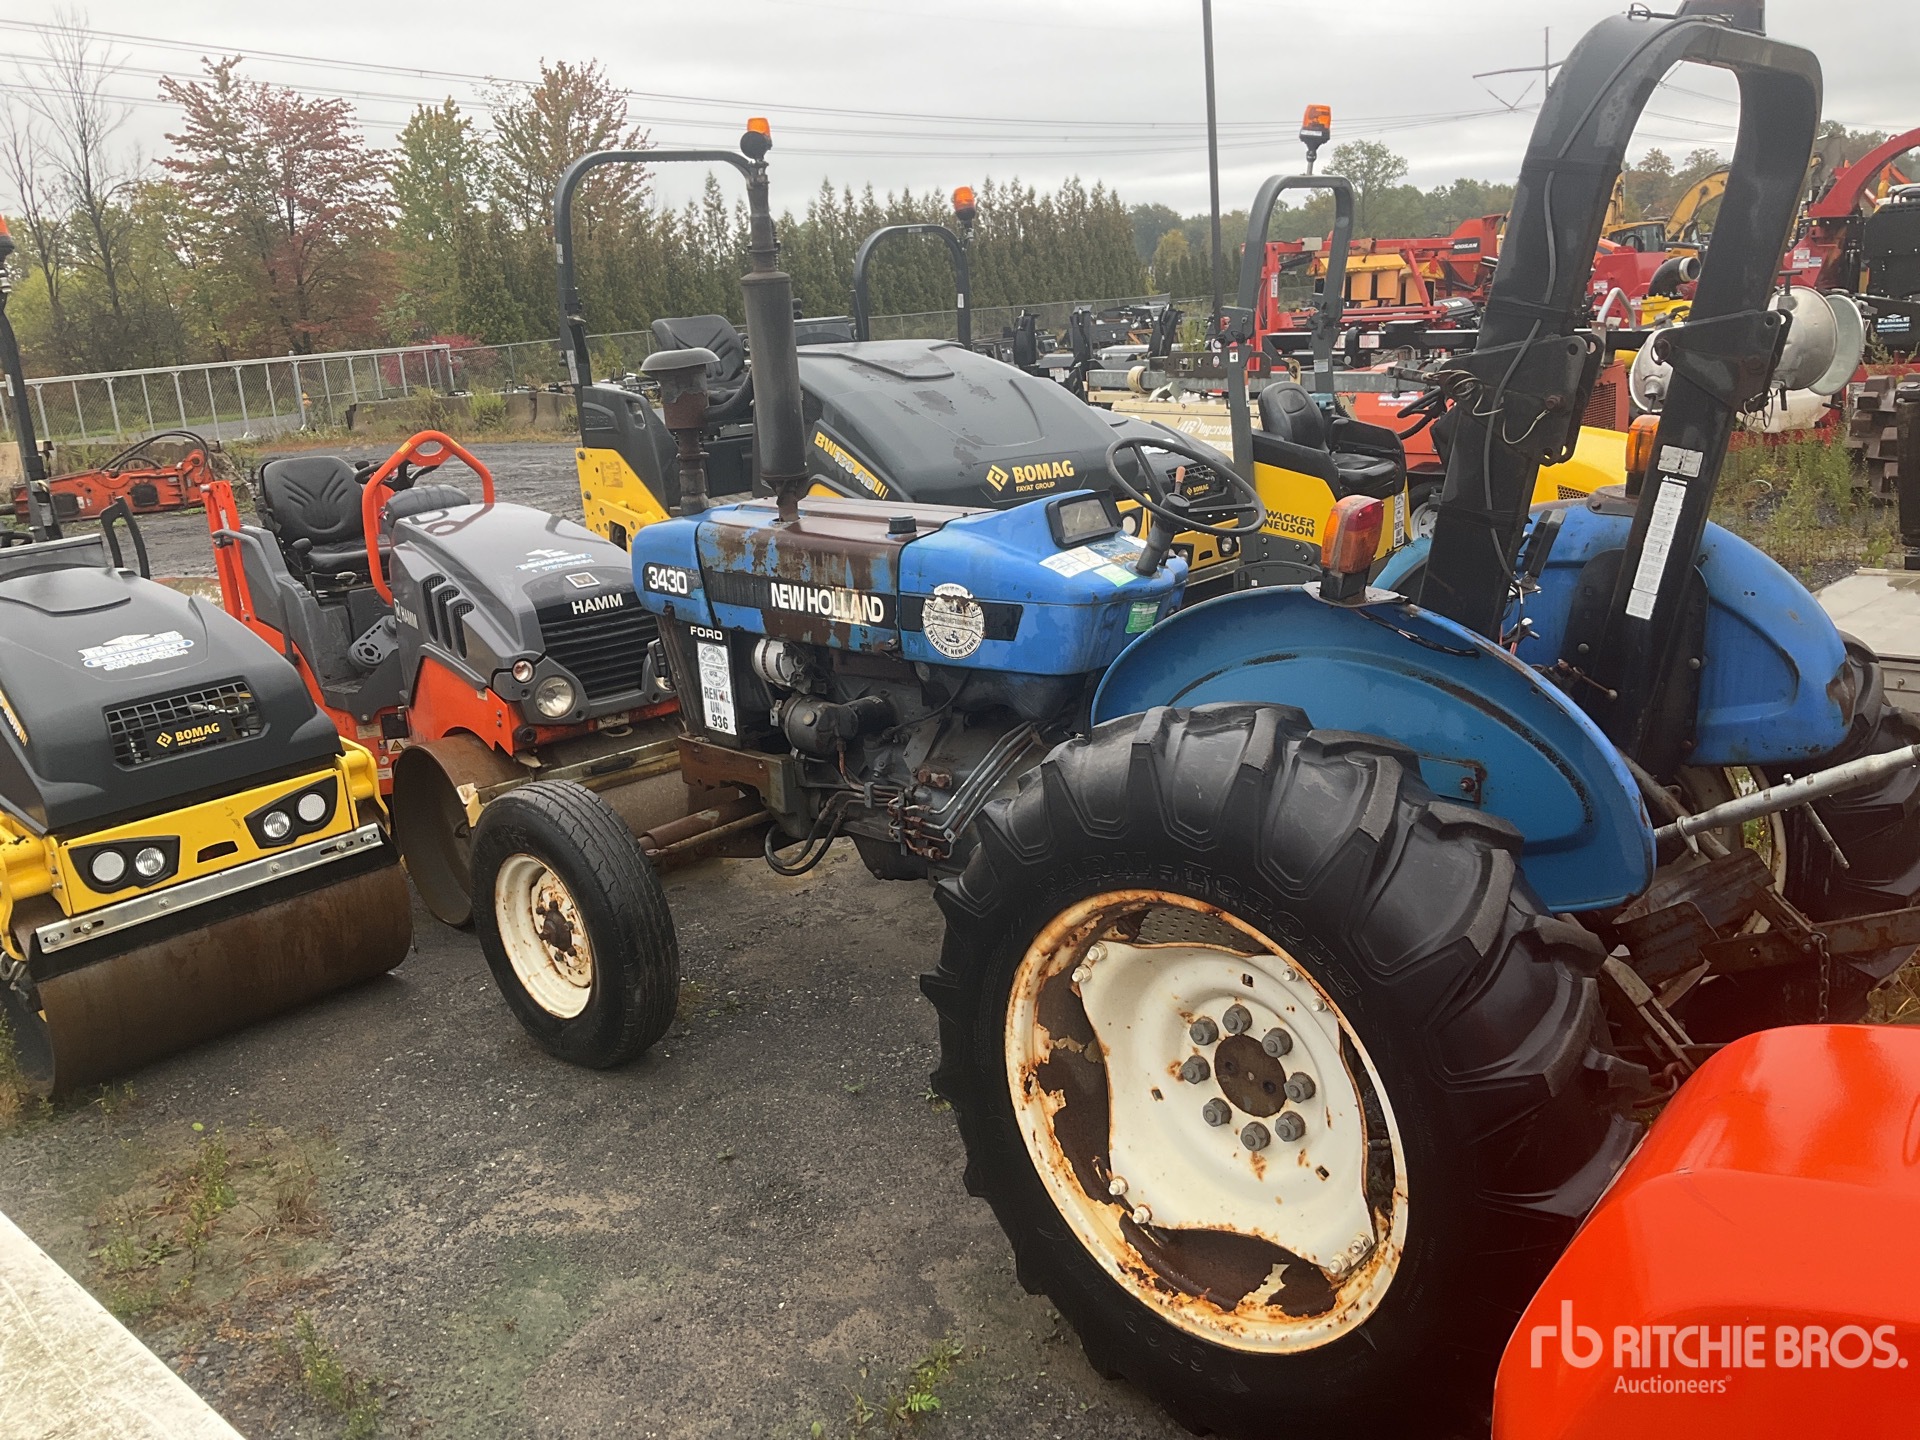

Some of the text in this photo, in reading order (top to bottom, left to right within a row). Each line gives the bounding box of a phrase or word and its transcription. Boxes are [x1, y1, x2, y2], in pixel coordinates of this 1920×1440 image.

[1012, 460, 1074, 484] BOMAG
[1016, 481, 1056, 492] FAYAT GROUP
[1264, 518, 1315, 537] NEUSON
[1266, 509, 1315, 528] WACKER
[648, 566, 688, 594] 3430
[571, 593, 623, 615] HAMM
[690, 625, 723, 640] FORD
[704, 686, 731, 704] RENTAL
[712, 714, 729, 730] 936
[175, 722, 220, 742] BOMAG
